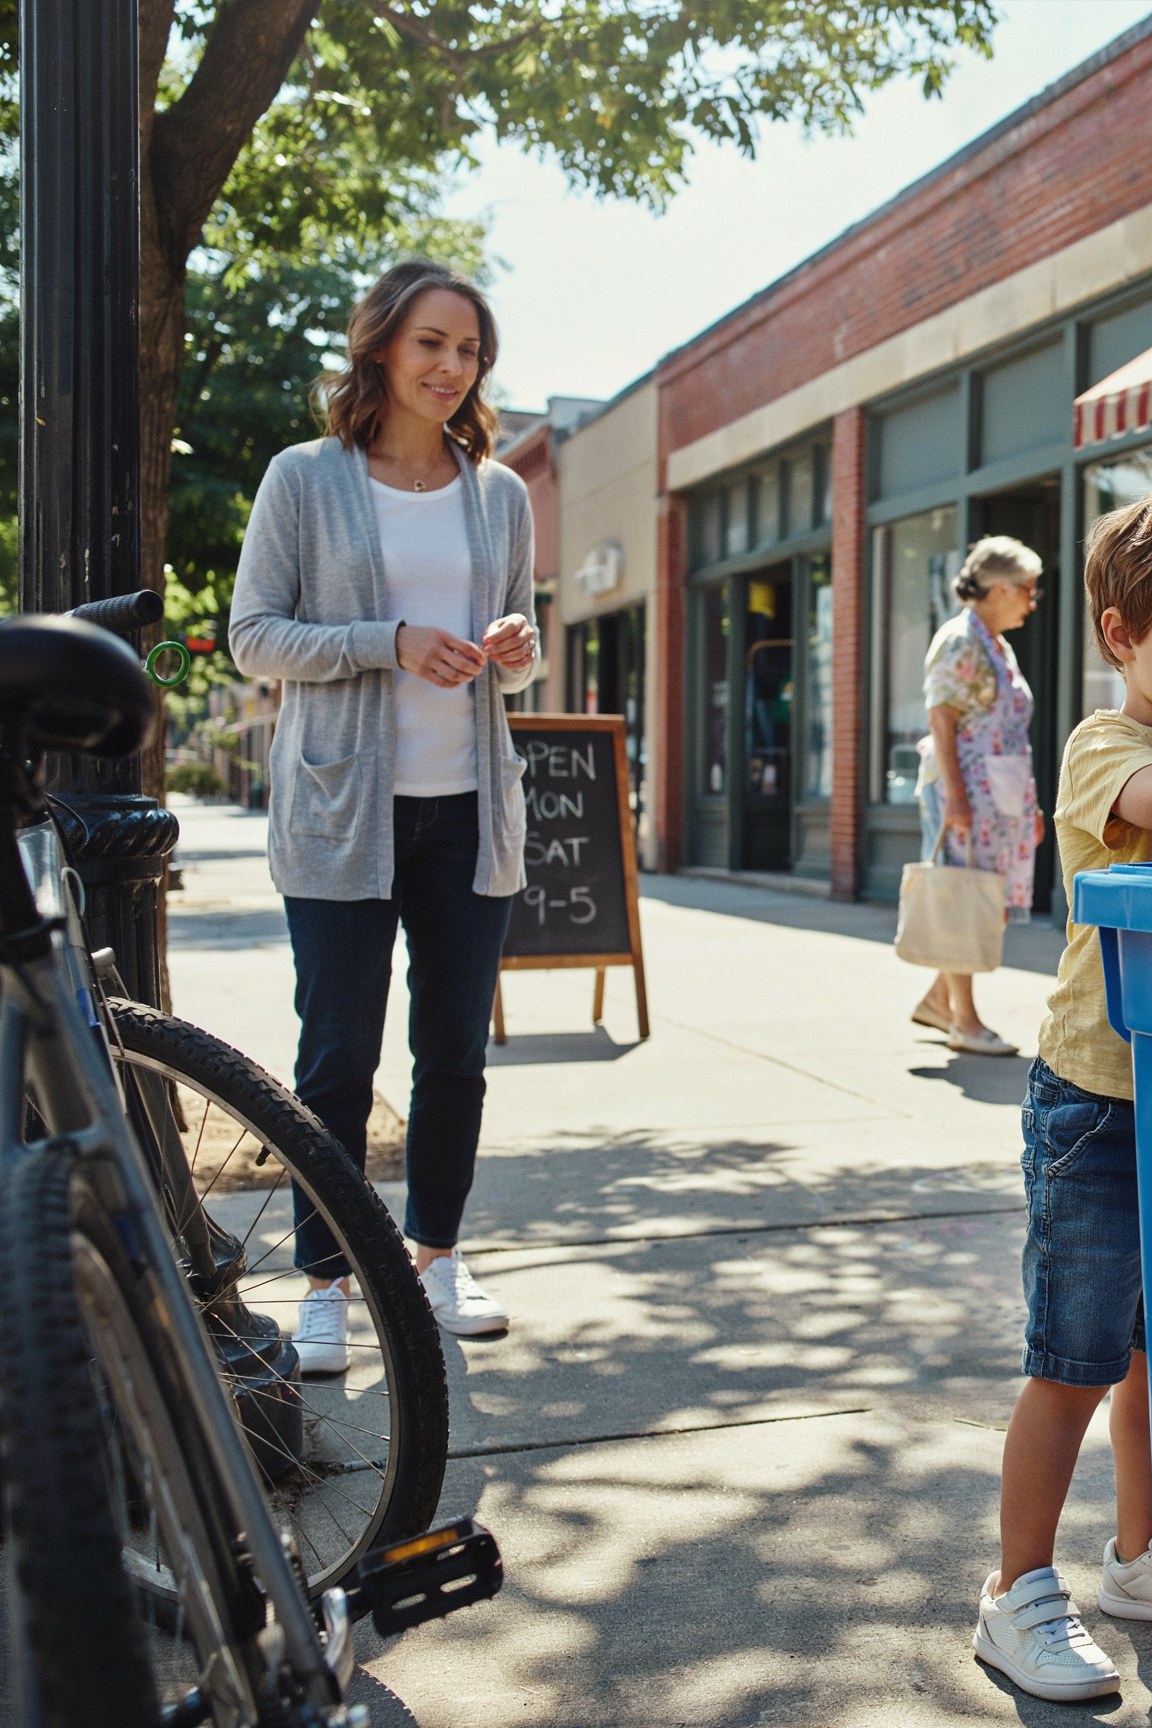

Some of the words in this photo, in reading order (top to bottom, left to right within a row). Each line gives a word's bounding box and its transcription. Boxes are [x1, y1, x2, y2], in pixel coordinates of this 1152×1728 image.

[514, 740, 596, 781] PEN
[525, 831, 591, 867] SAT
[523, 885, 597, 926] 9-5
